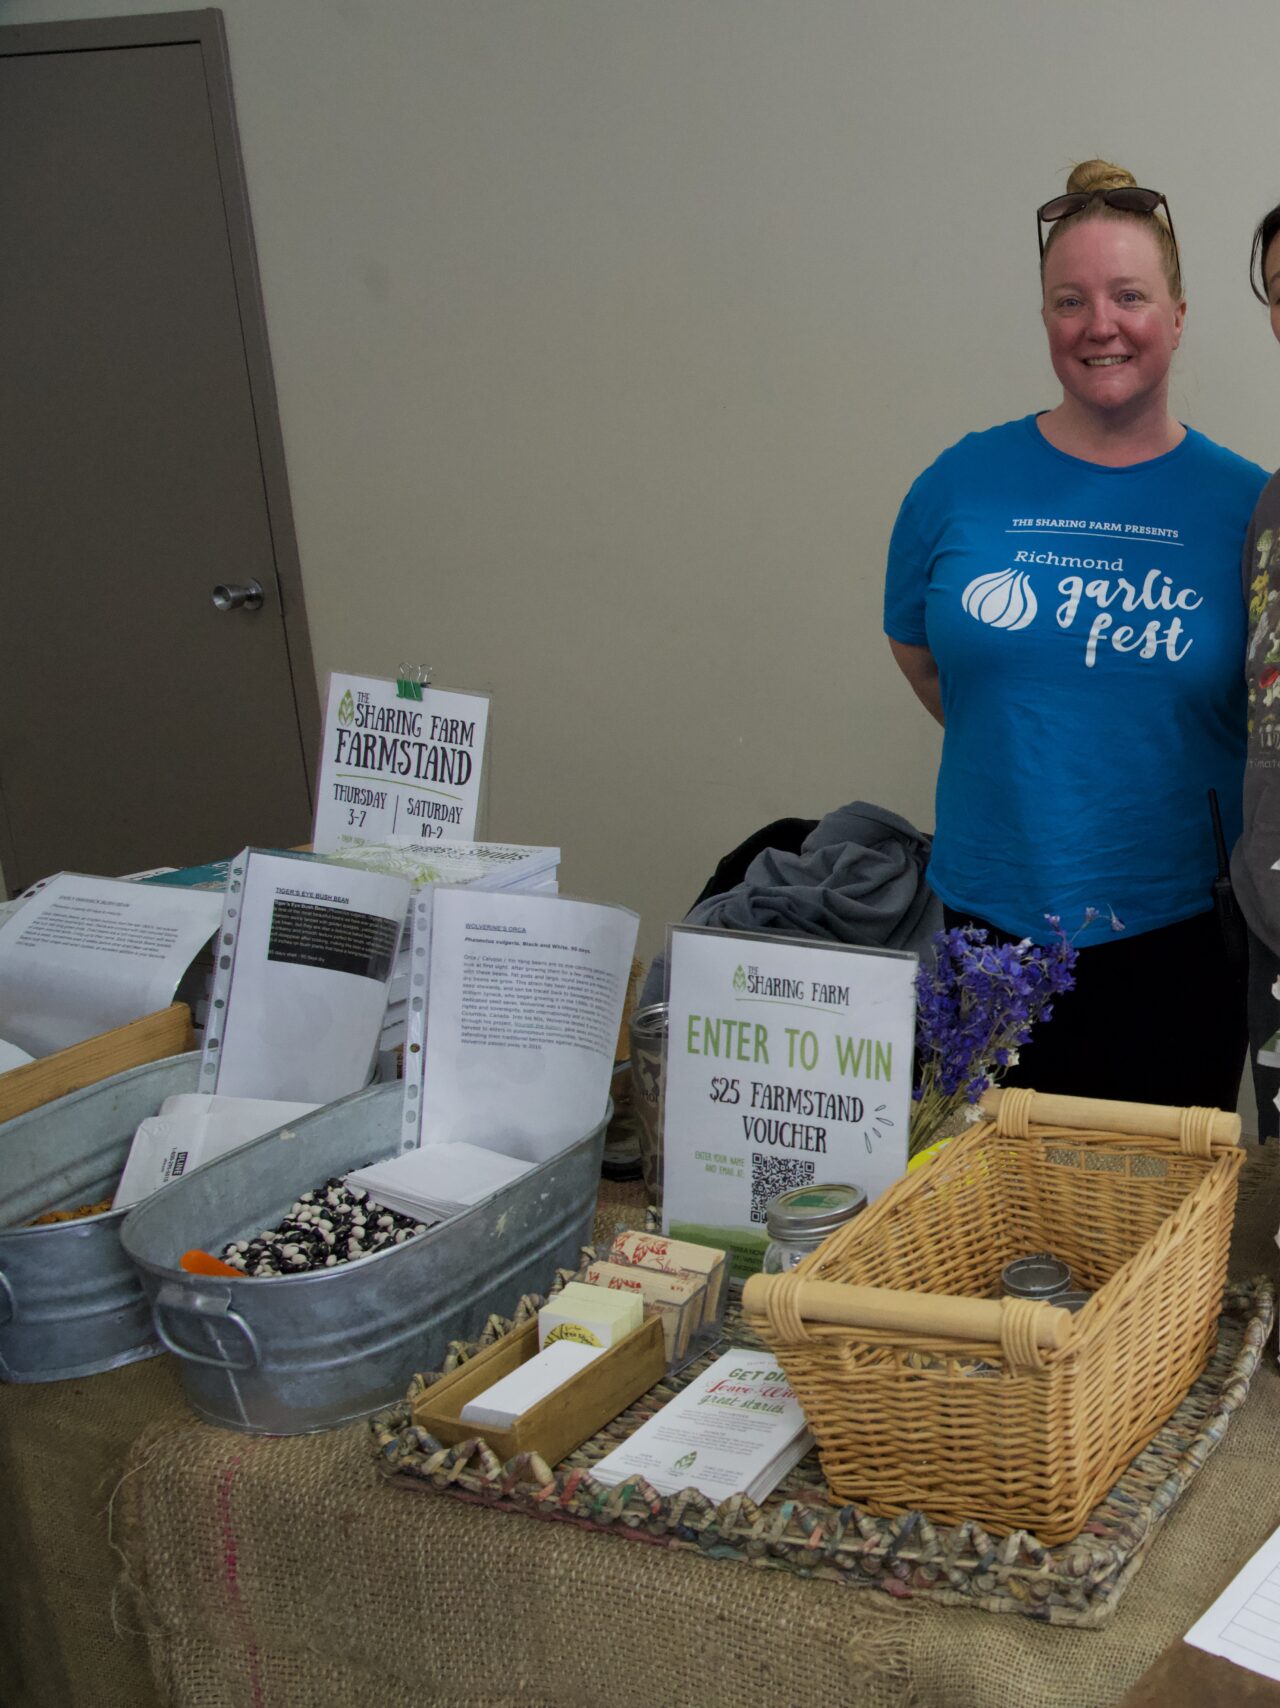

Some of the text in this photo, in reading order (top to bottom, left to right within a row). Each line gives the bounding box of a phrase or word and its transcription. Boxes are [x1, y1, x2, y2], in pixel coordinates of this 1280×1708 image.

[1012, 518, 1179, 539] THE SHARING FARM PRESENTS
[1013, 550, 1124, 572] Richmond
[1056, 568, 1204, 629] garlic
[1085, 612, 1194, 668] fest
[357, 691, 371, 704] THE
[354, 703, 476, 748] SHARING FARM
[334, 728, 472, 786] FARMSTAND
[333, 783, 464, 825] THURSDAY SATURDAY
[348, 809, 367, 828] 3-7
[747, 974, 851, 1006] SHARING FARM
[687, 1014, 893, 1083] ENTER TO WIN
[709, 1076, 865, 1123] $25 FARMSTAND
[742, 1115, 827, 1154] VOUCHER
[173, 1152, 187, 1175] ULINE
[728, 1368, 764, 1382] GET
[697, 1394, 739, 1406] great
